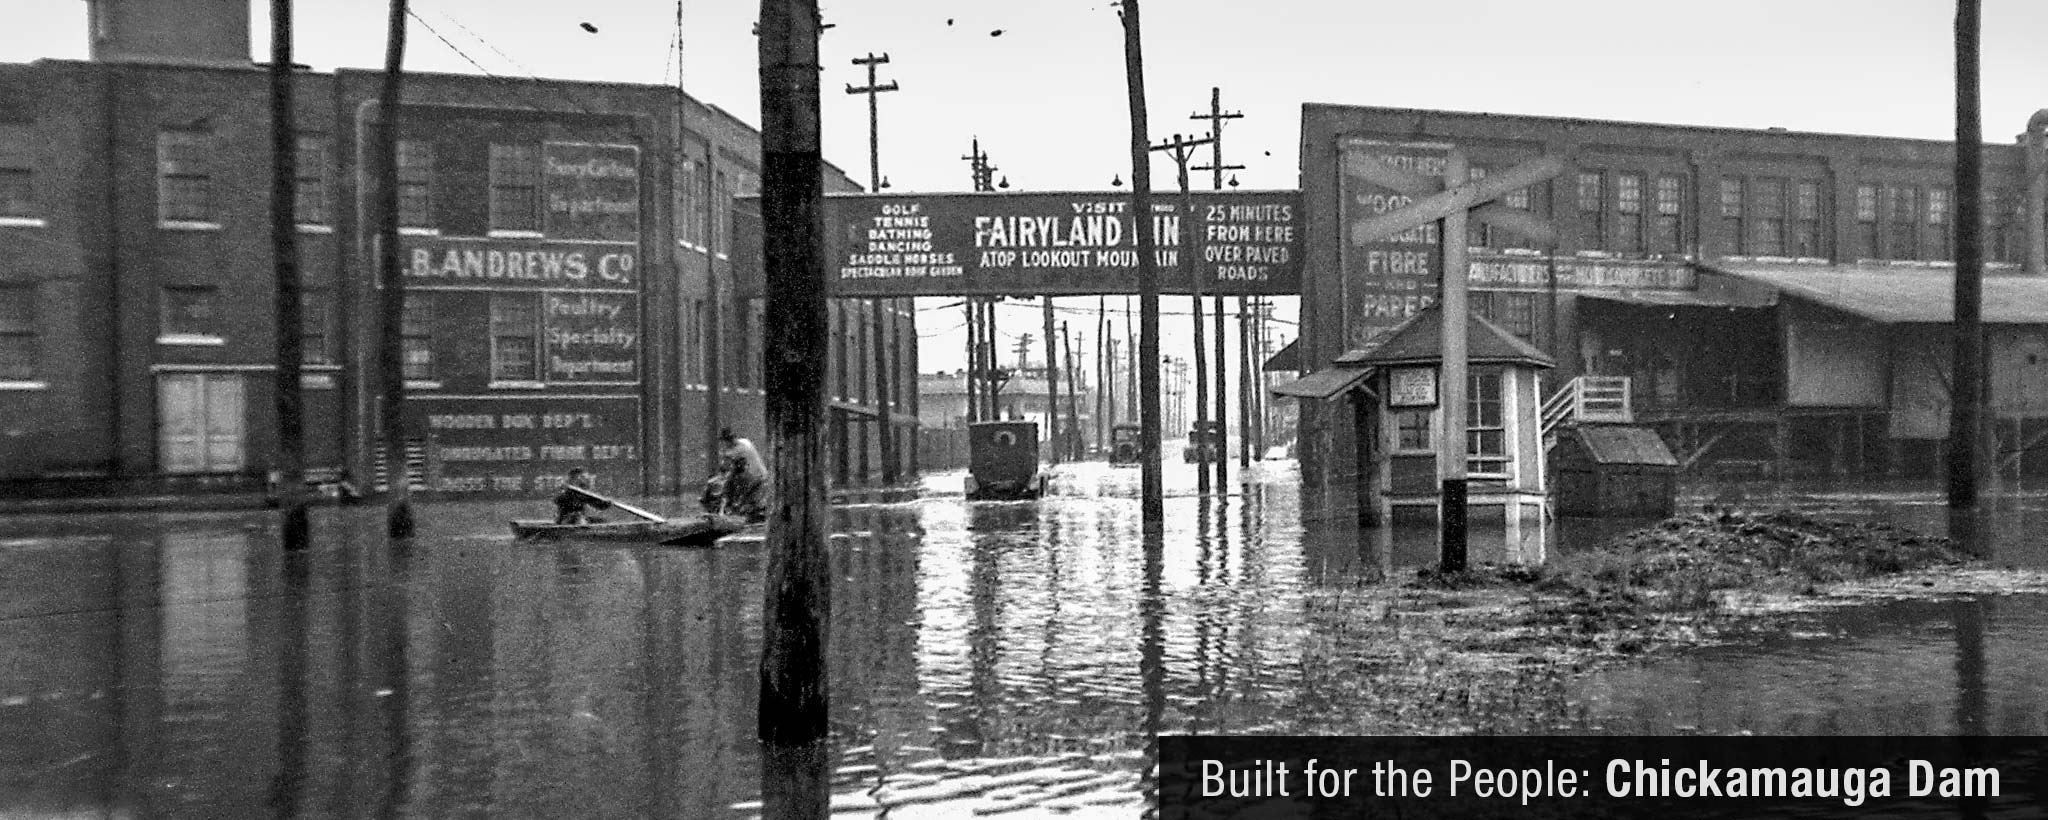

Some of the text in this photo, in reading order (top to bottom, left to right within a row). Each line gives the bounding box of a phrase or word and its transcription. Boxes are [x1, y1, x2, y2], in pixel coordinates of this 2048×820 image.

[882, 204, 919, 215] GOLF
[1072, 202, 1126, 213] VISIT
[1206, 204, 1292, 221] 25 MINUTES
[874, 216, 929, 228] TENNIS
[868, 229, 932, 240] BATHING
[974, 216, 1179, 247] FAIRYLAND IN
[1207, 225, 1294, 243] FROM HERE
[868, 241, 932, 252] DANCING
[1205, 246, 1289, 263] OVER PAVED
[848, 253, 954, 265] SADDLE HORSES
[979, 250, 1178, 267] ATOP LOOKOUT MOUNIN
[1369, 251, 1428, 274] FIBRE
[1218, 265, 1268, 281] ROADS
[550, 297, 620, 320] Poultry
[545, 327, 635, 350] Specialty
[440, 446, 532, 461] ORRUGATED
